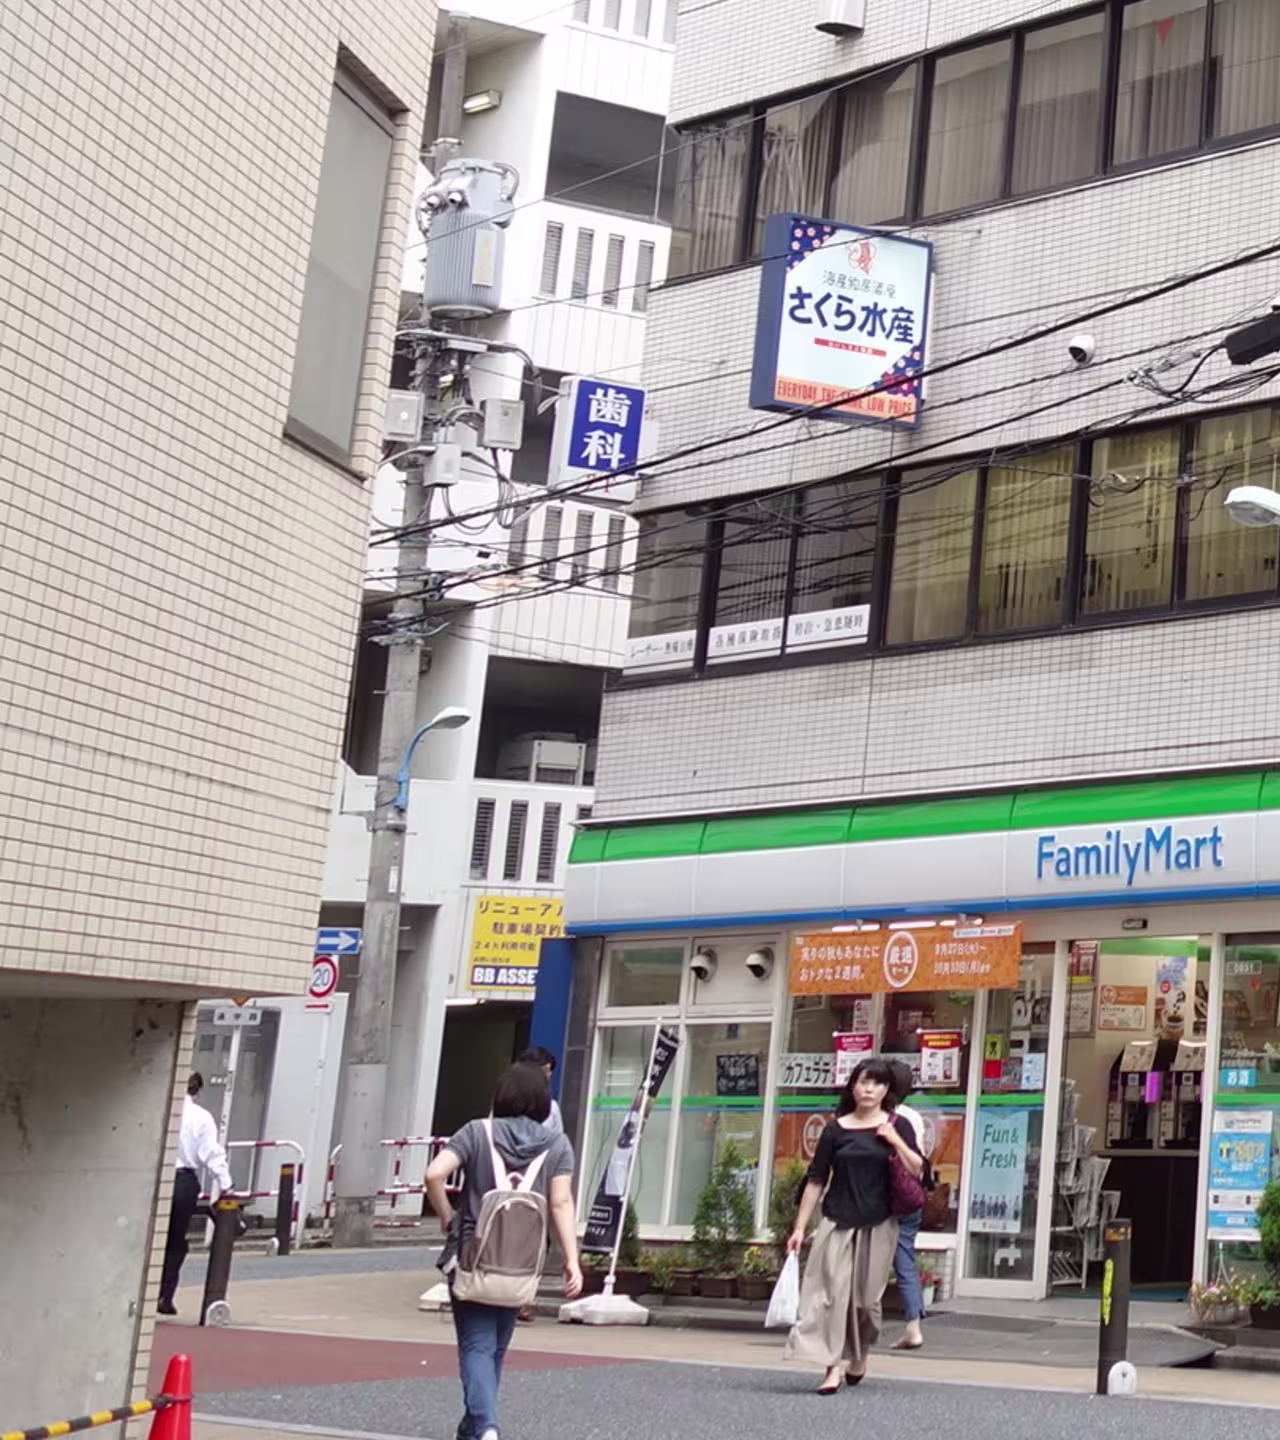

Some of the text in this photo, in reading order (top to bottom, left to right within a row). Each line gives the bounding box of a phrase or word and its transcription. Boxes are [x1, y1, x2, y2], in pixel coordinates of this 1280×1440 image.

[788, 286, 915, 344] さくら水産
[777, 379, 817, 401] EVERYDAY
[580, 388, 632, 469] 歯科
[1037, 825, 1224, 887] FamilyMart
[312, 968, 331, 987] 20
[473, 966, 496, 983] BB
[983, 1123, 1020, 1145] Fun&
[980, 1148, 1019, 1169] Fresh
